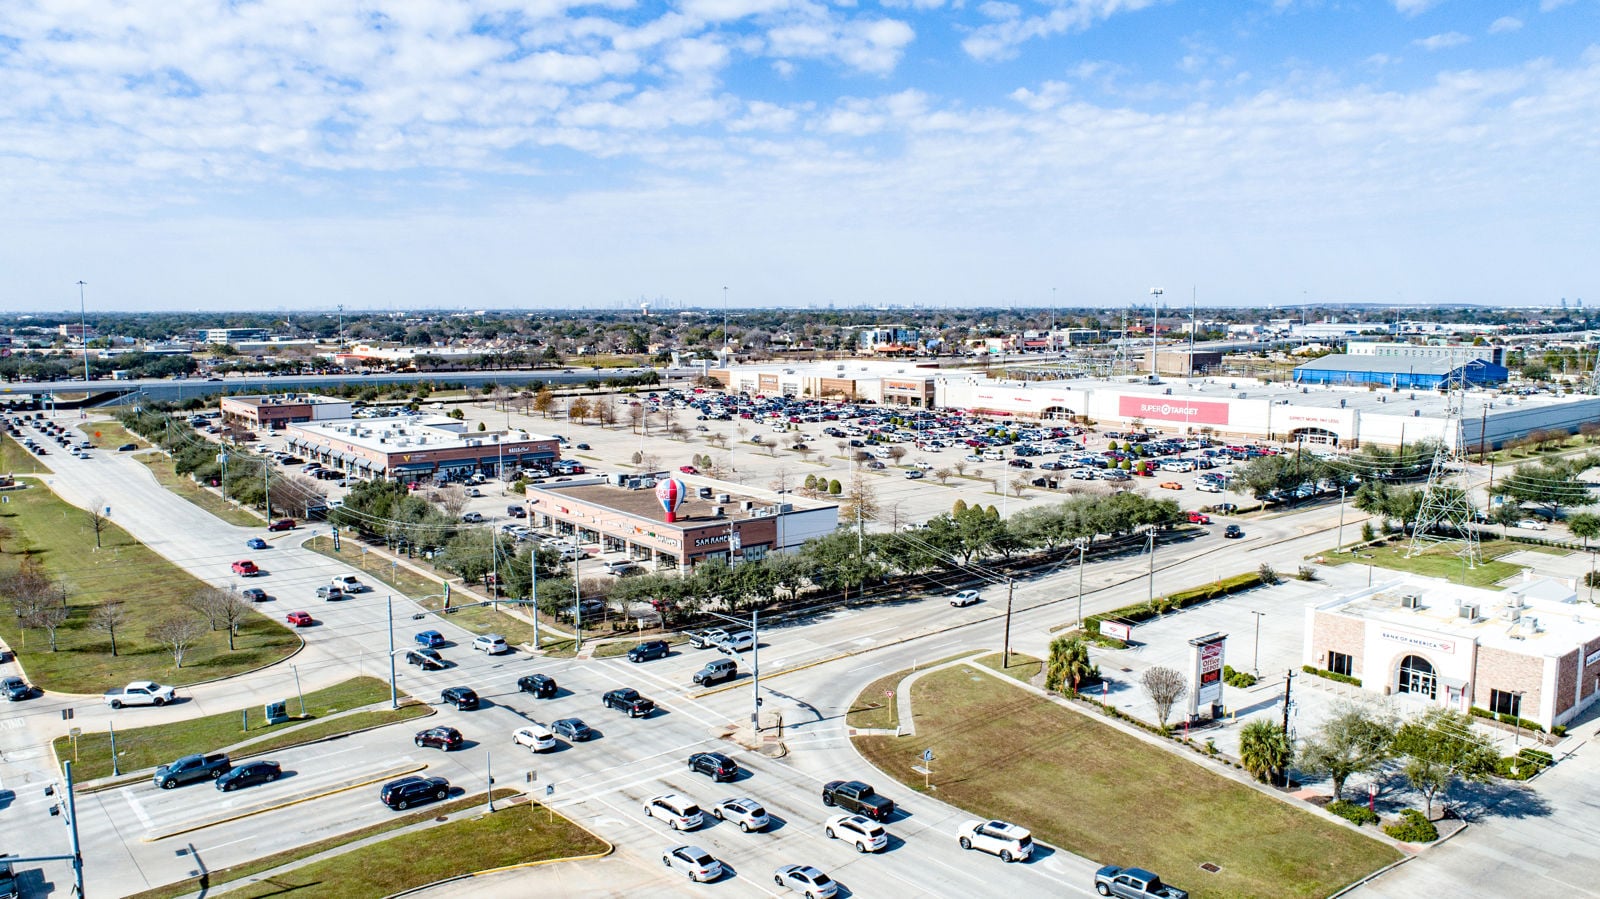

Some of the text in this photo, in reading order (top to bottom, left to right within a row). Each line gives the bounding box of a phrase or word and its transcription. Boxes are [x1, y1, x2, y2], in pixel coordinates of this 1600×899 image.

[1141, 404, 1198, 415] SUPER TARGET
[695, 538, 710, 547] SAM
[1409, 639, 1437, 648] AMERICA
[1203, 658, 1220, 667] Office
[1203, 664, 1219, 673] DEPOT
